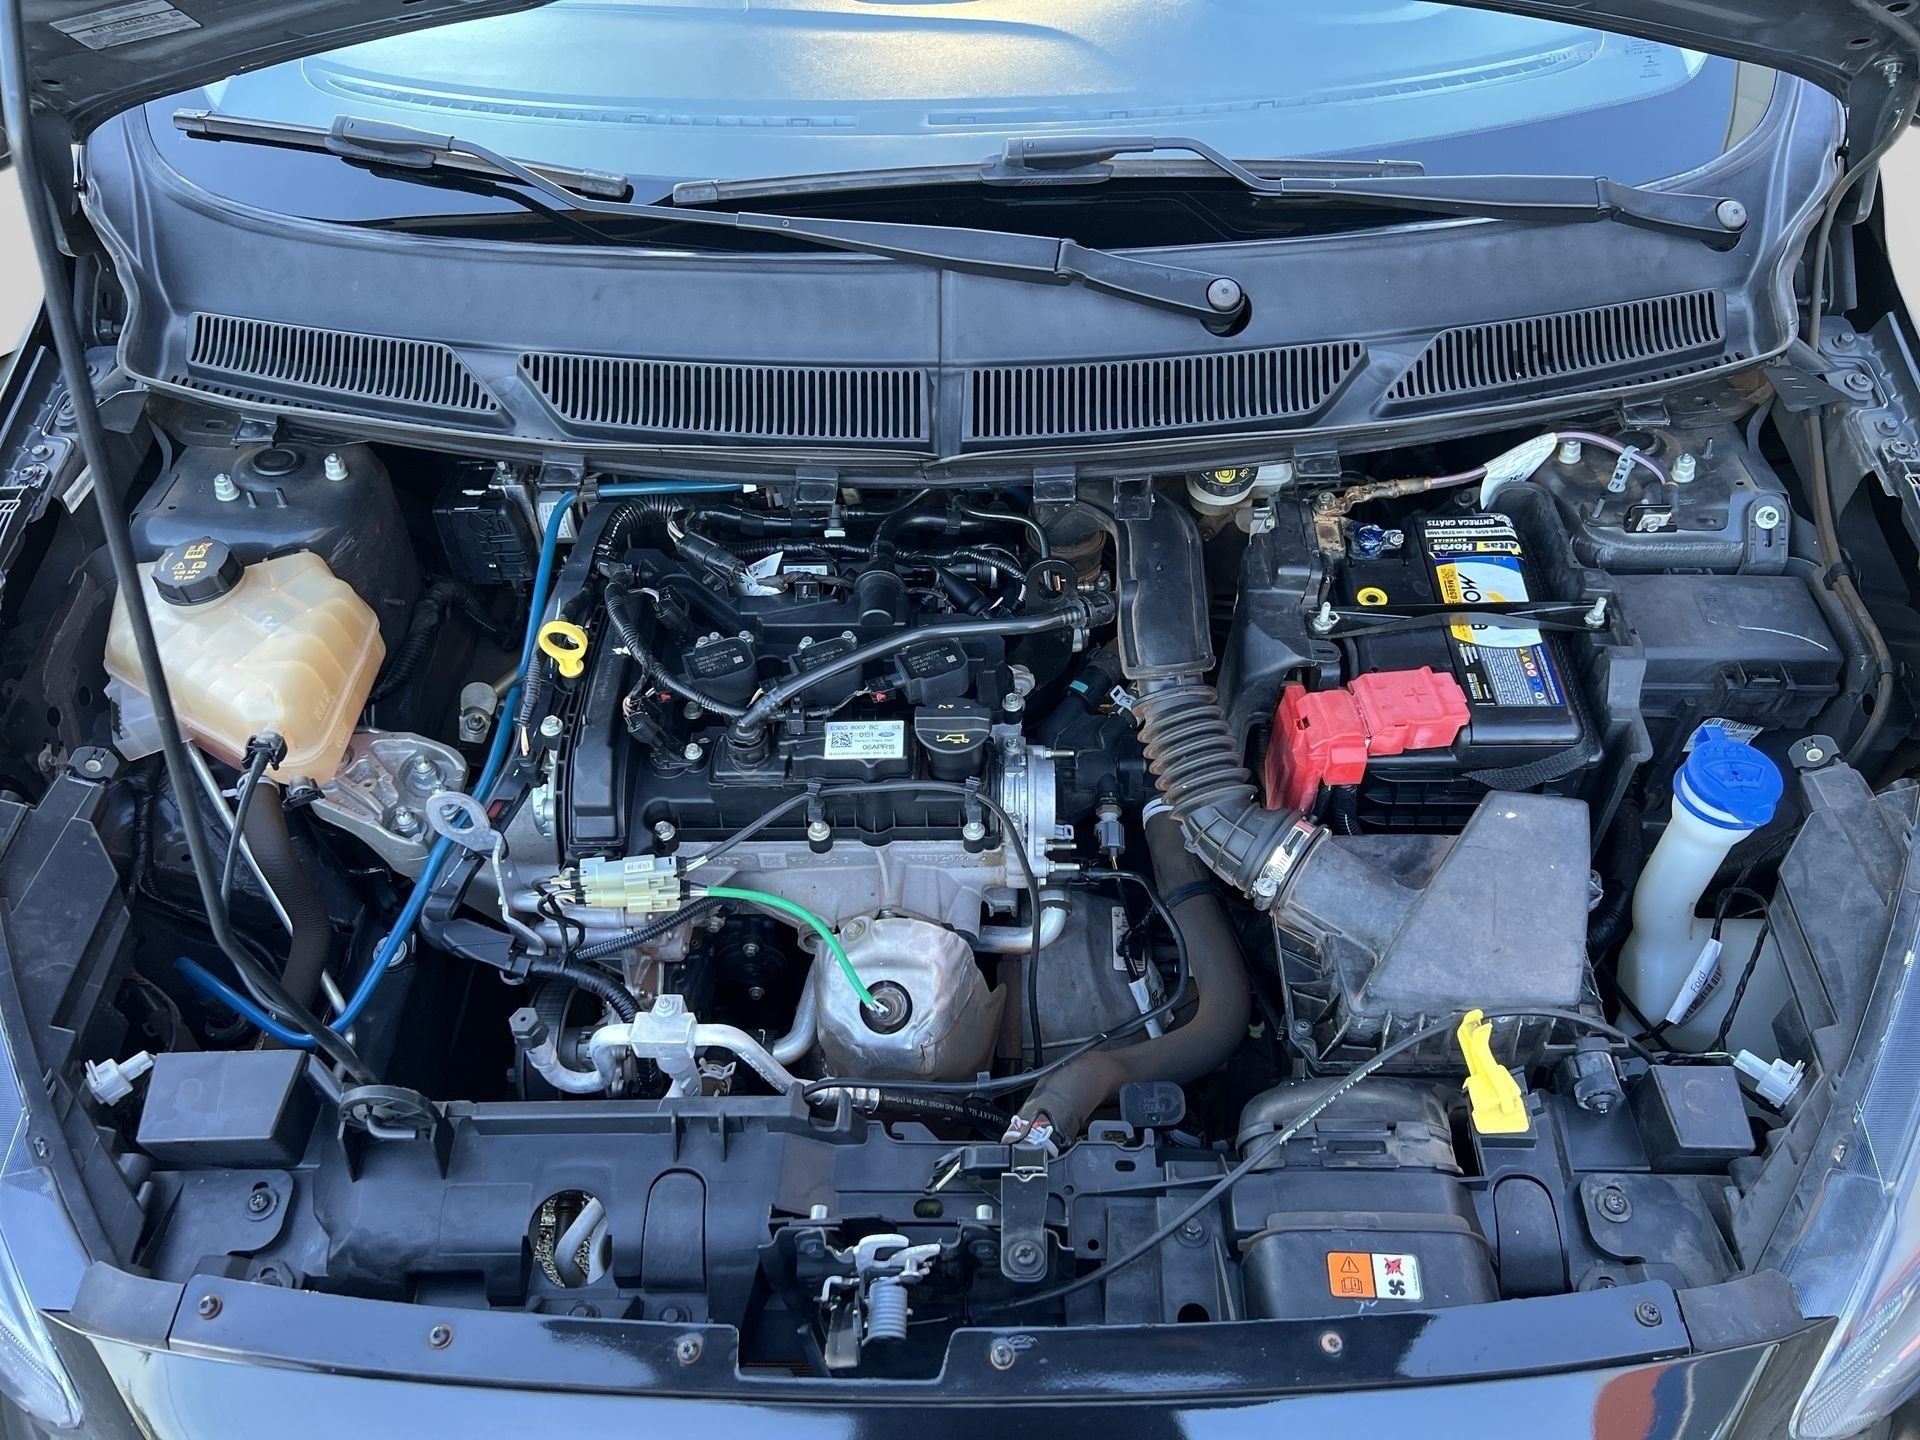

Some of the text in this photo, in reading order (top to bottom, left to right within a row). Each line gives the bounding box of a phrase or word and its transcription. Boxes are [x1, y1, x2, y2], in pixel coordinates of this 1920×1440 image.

[91, 14, 161, 34] AUTODIAGNOSE
[1426, 518, 1495, 528] ENTREGA GRÁTIS
[1432, 542, 1517, 551] Altas Horas
[1690, 970, 1707, 994] Ford
[928, 1101, 944, 1110] HOSE
